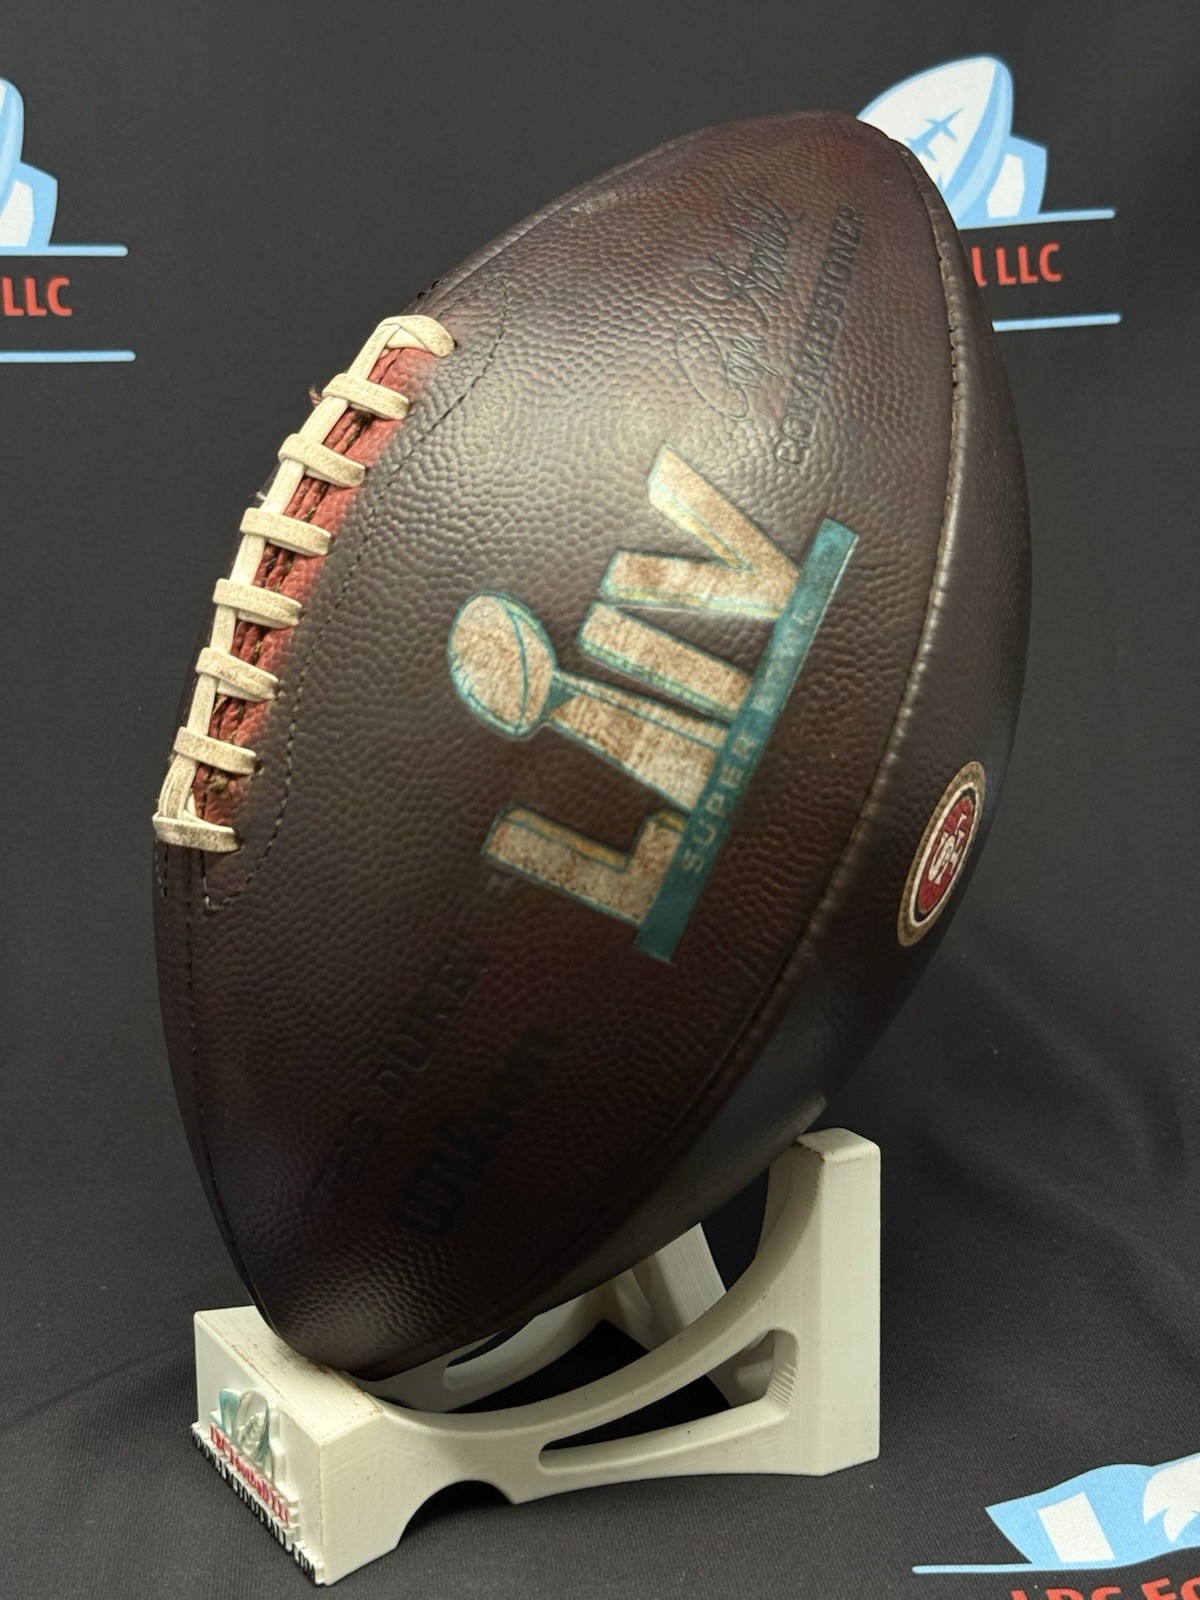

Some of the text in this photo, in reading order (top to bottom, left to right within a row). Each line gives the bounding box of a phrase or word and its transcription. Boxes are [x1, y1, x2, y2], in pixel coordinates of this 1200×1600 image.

[995, 242, 1063, 287] LLC
[2, 276, 73, 317] LLC
[681, 732, 760, 874] SUPER
